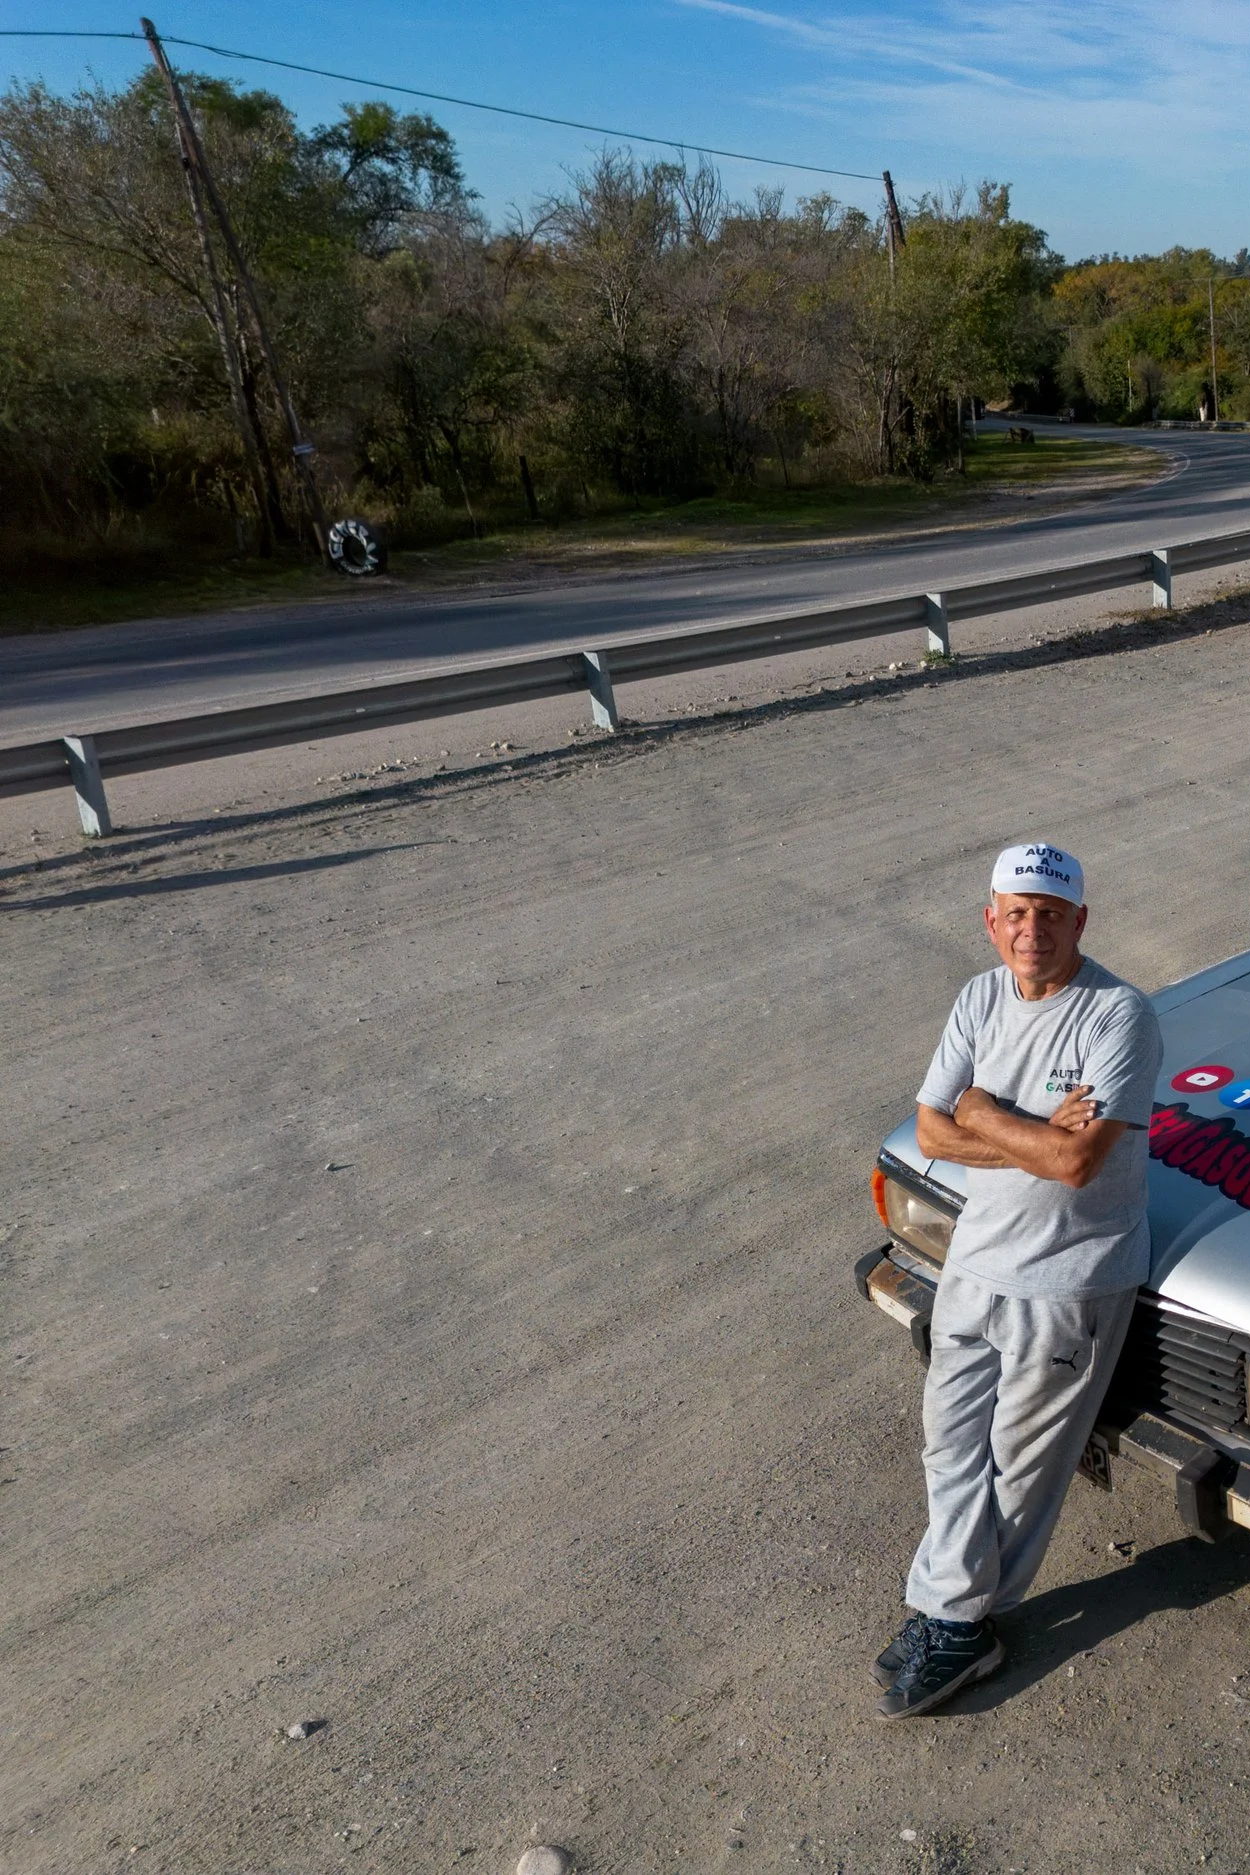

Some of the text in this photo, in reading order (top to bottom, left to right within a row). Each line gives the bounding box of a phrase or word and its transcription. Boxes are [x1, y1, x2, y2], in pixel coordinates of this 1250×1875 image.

[1026, 846, 1063, 862] AUTO
[1040, 857, 1050, 867] A
[1015, 865, 1070, 885] BASURA
[1049, 1068, 1083, 1081] AUTO
